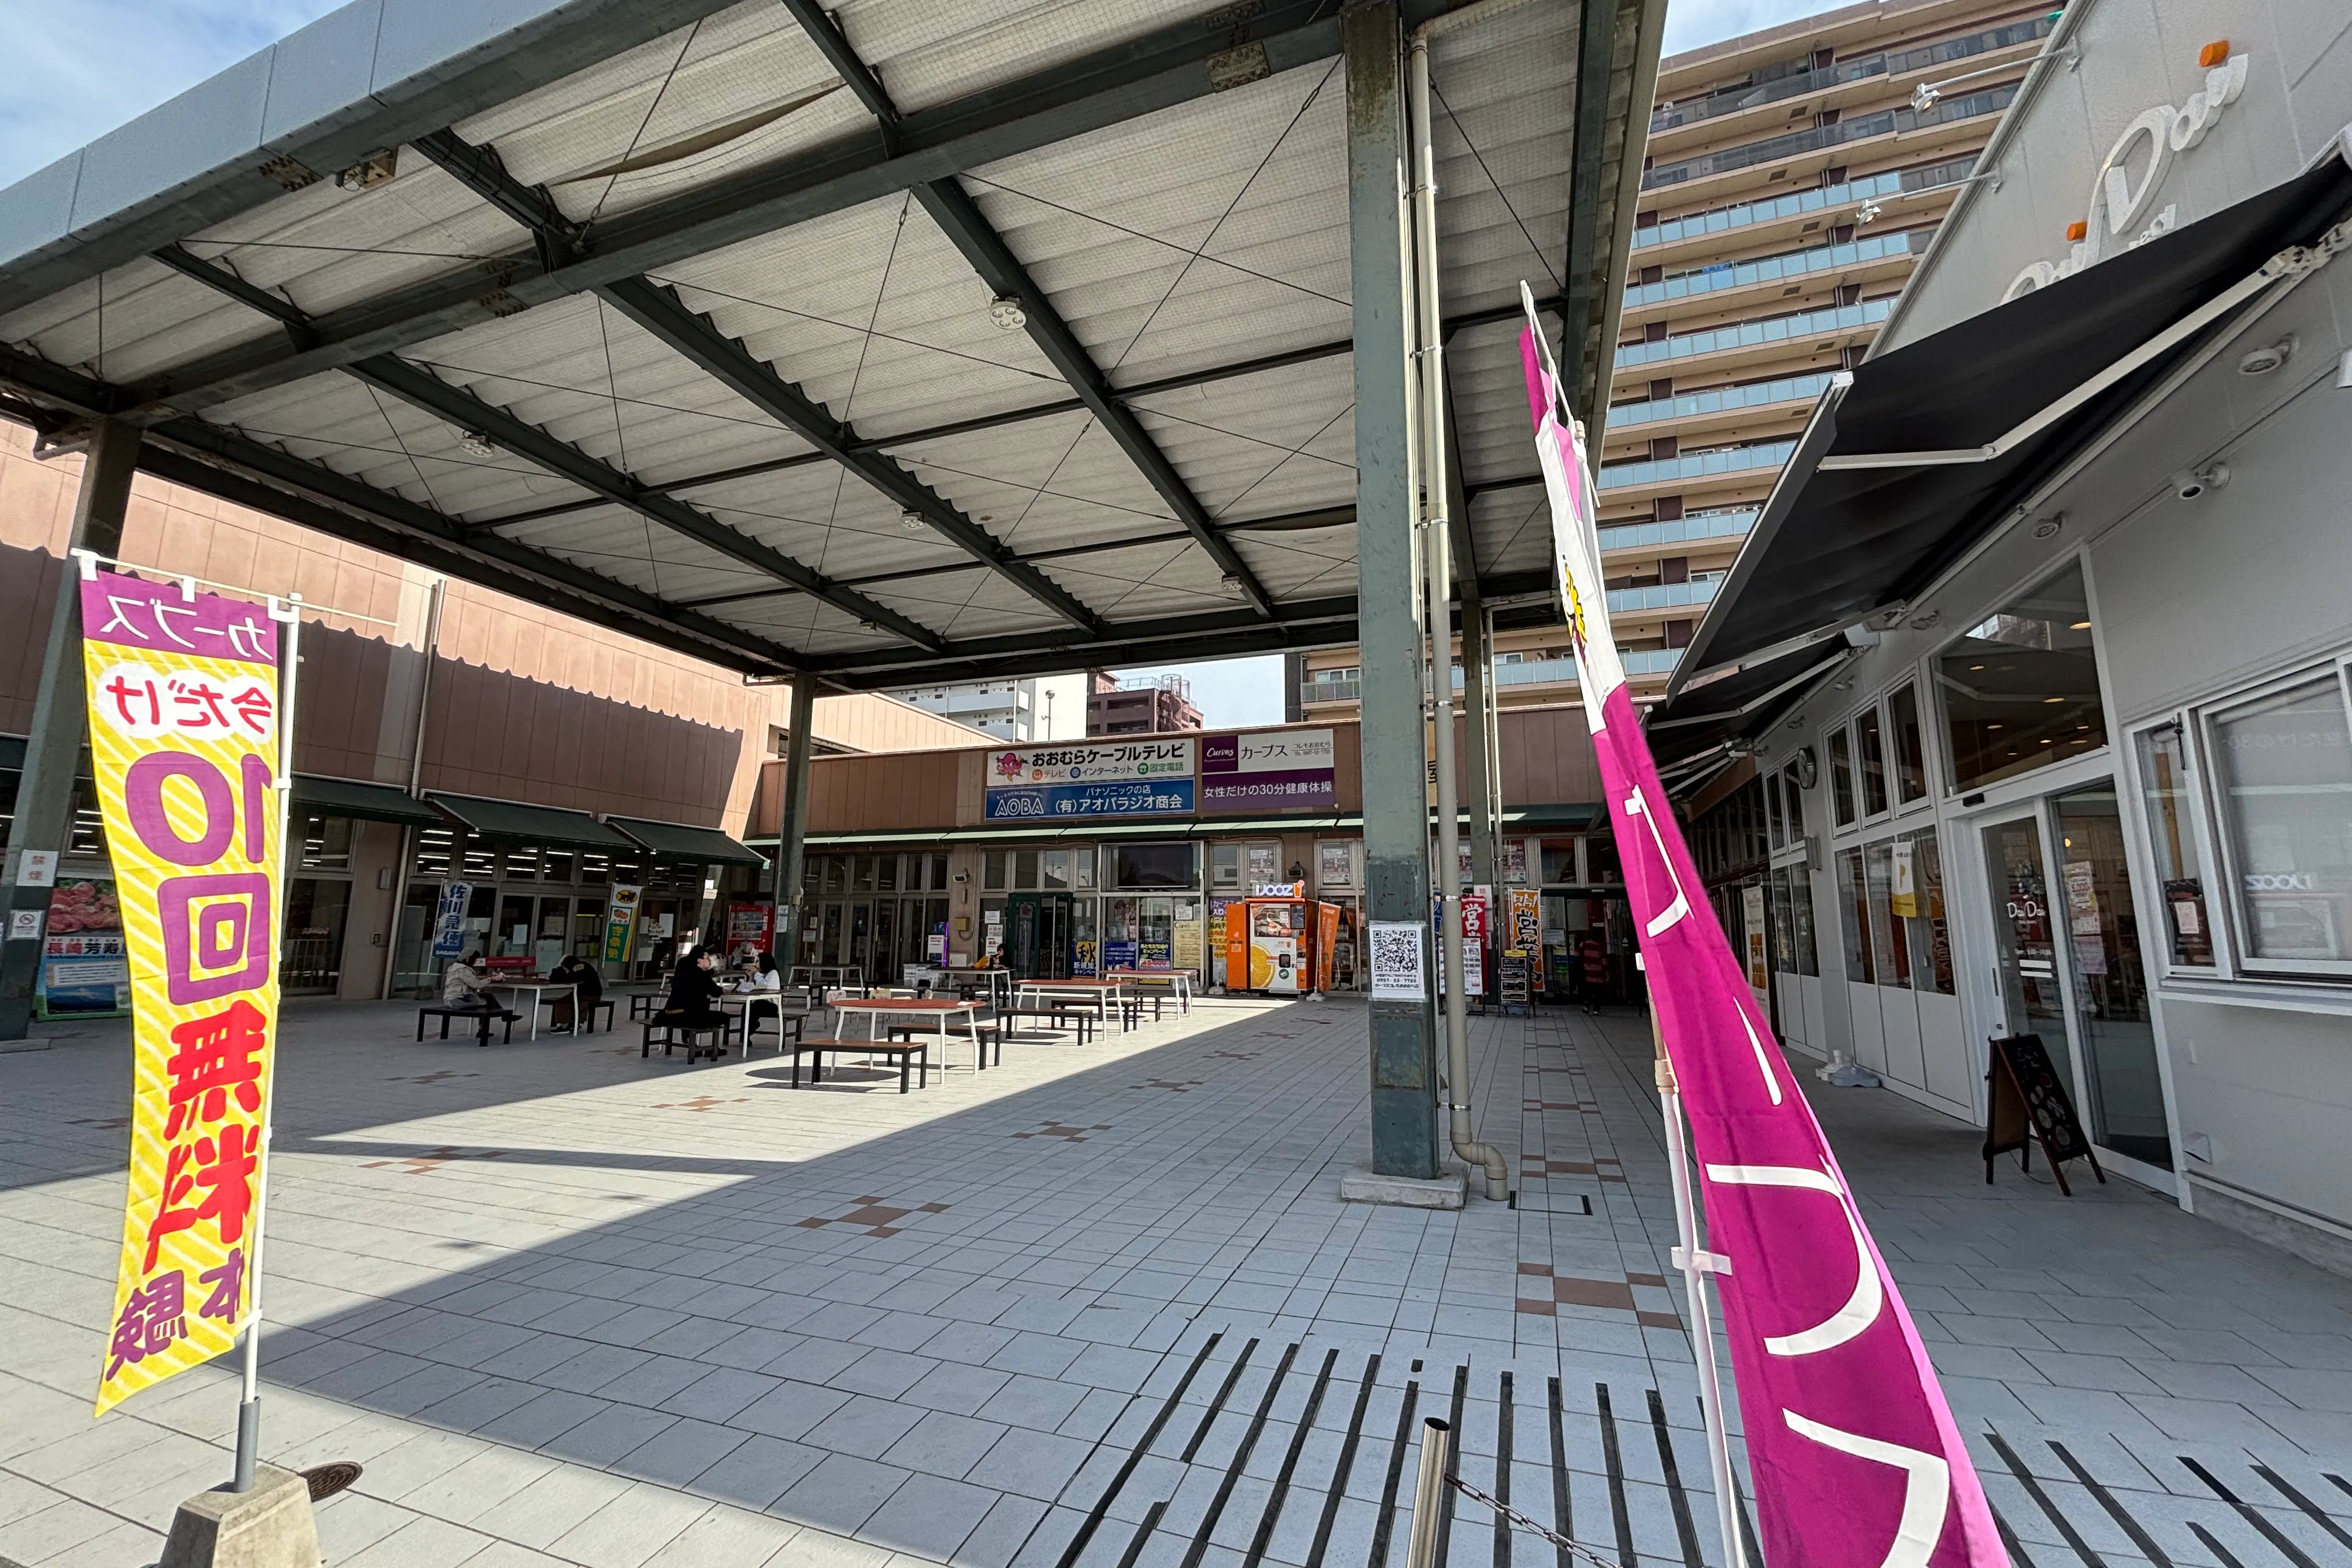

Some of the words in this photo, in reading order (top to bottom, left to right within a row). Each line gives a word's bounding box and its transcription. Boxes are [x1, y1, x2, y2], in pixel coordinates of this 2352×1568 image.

[1206, 747, 1234, 758] Curves
[1241, 744, 1288, 760] カーブス
[1294, 740, 1331, 749] コレモおおむら
[1032, 743, 1186, 767] おおむらケーブルテレビ
[1044, 769, 1066, 778] テレビ
[1081, 765, 1133, 777] インターネット
[1149, 762, 1184, 773] 固定電話
[1086, 785, 1151, 797] パナソニックの店
[1203, 780, 1332, 799] 女性だけの30分健康体操
[995, 797, 1044, 816] AOBA
[442, 884, 467, 945] 佐川急便
[1077, 943, 1096, 963] 秋
[1073, 961, 1097, 970] 新規加
